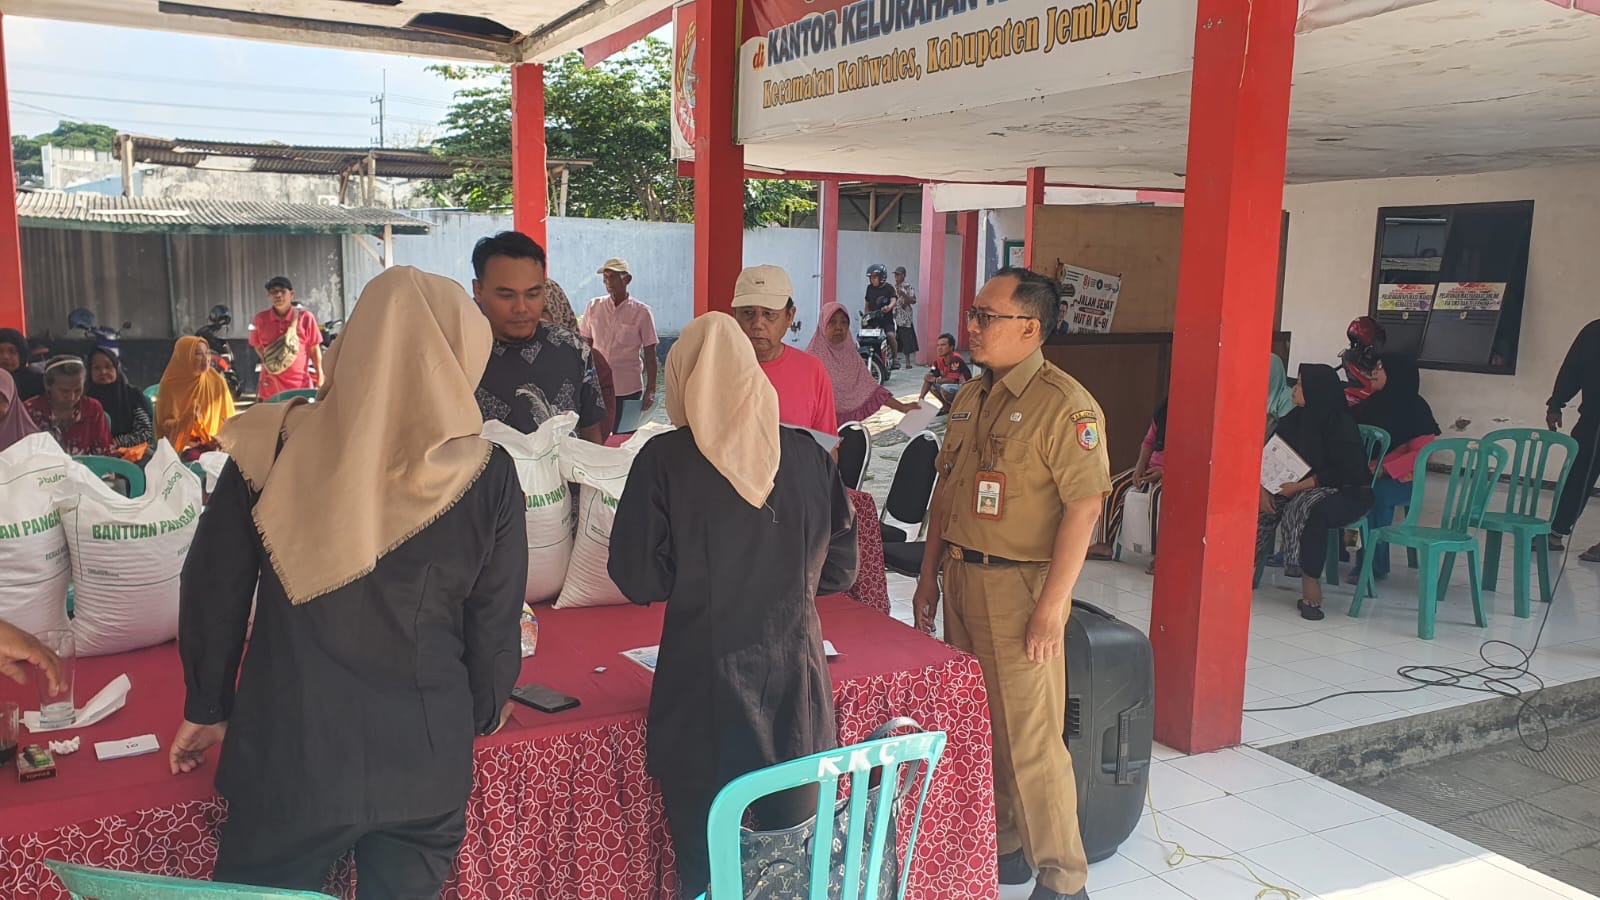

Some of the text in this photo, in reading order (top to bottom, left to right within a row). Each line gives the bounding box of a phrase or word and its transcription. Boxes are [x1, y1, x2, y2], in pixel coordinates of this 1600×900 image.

[752, 0, 978, 70] di KANTOR KELURAH
[763, 0, 1142, 109] Kecamatan Kaliwates, Kabupaten Jember
[0, 523, 20, 539] AN
[92, 522, 157, 541] BANTUAN
